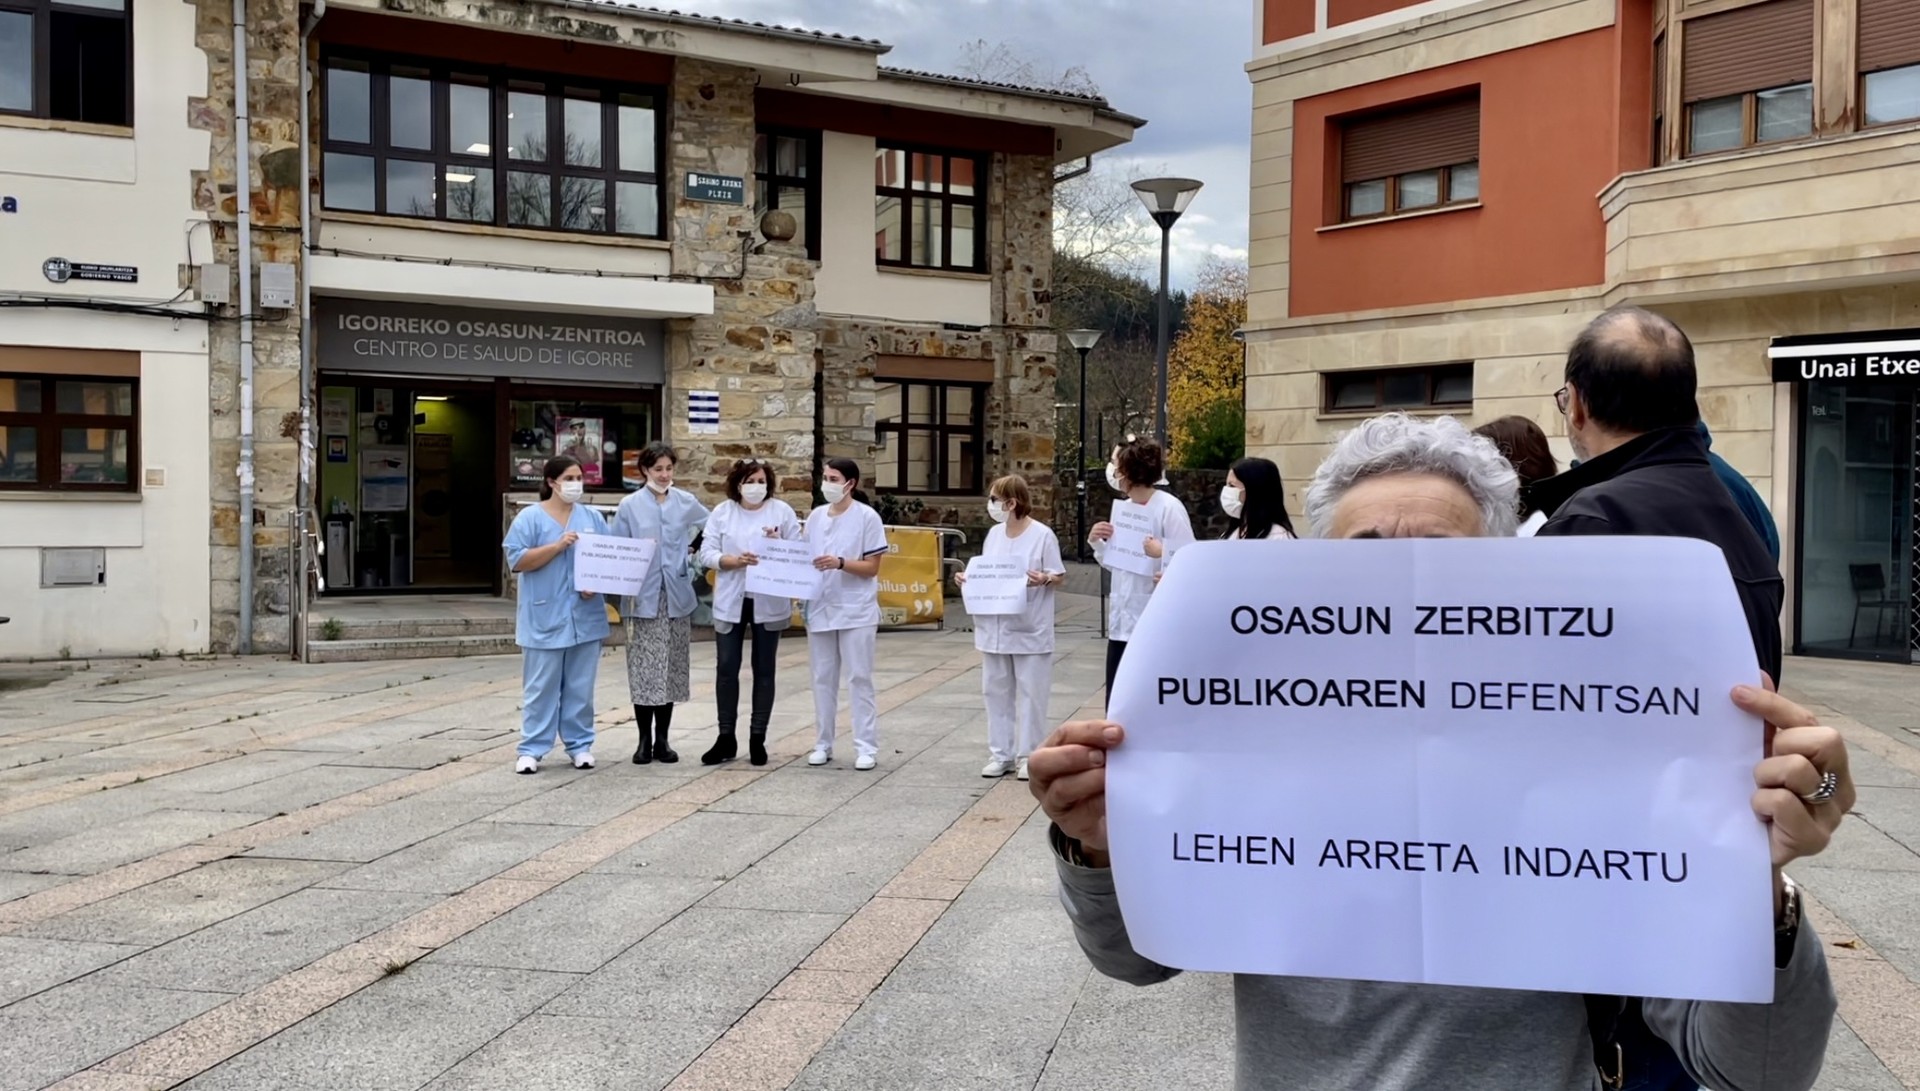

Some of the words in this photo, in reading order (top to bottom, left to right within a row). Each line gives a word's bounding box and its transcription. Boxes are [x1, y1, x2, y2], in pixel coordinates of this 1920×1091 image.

[0, 196, 17, 213] a
[338, 314, 450, 335] IGORREKO
[456, 321, 646, 346] OSASUN-ZENTROA
[353, 338, 437, 359] CENTRO
[443, 344, 468, 360] DE
[473, 345, 533, 363] SALUD
[538, 348, 562, 365] DE
[567, 350, 633, 368] IGORRE
[1801, 357, 1856, 379] Unai
[1866, 356, 1920, 376] Etxe
[910, 580, 927, 593] da
[1230, 605, 1391, 635] OSASUN
[1413, 605, 1614, 637] ZERBITZU
[1158, 677, 1426, 708] PUBLIKOAREN
[1451, 681, 1700, 715] DEFENTSAN
[1173, 832, 1295, 865] LEHEN
[1318, 838, 1480, 873] ARRETA
[1504, 845, 1688, 883] INDARTU
